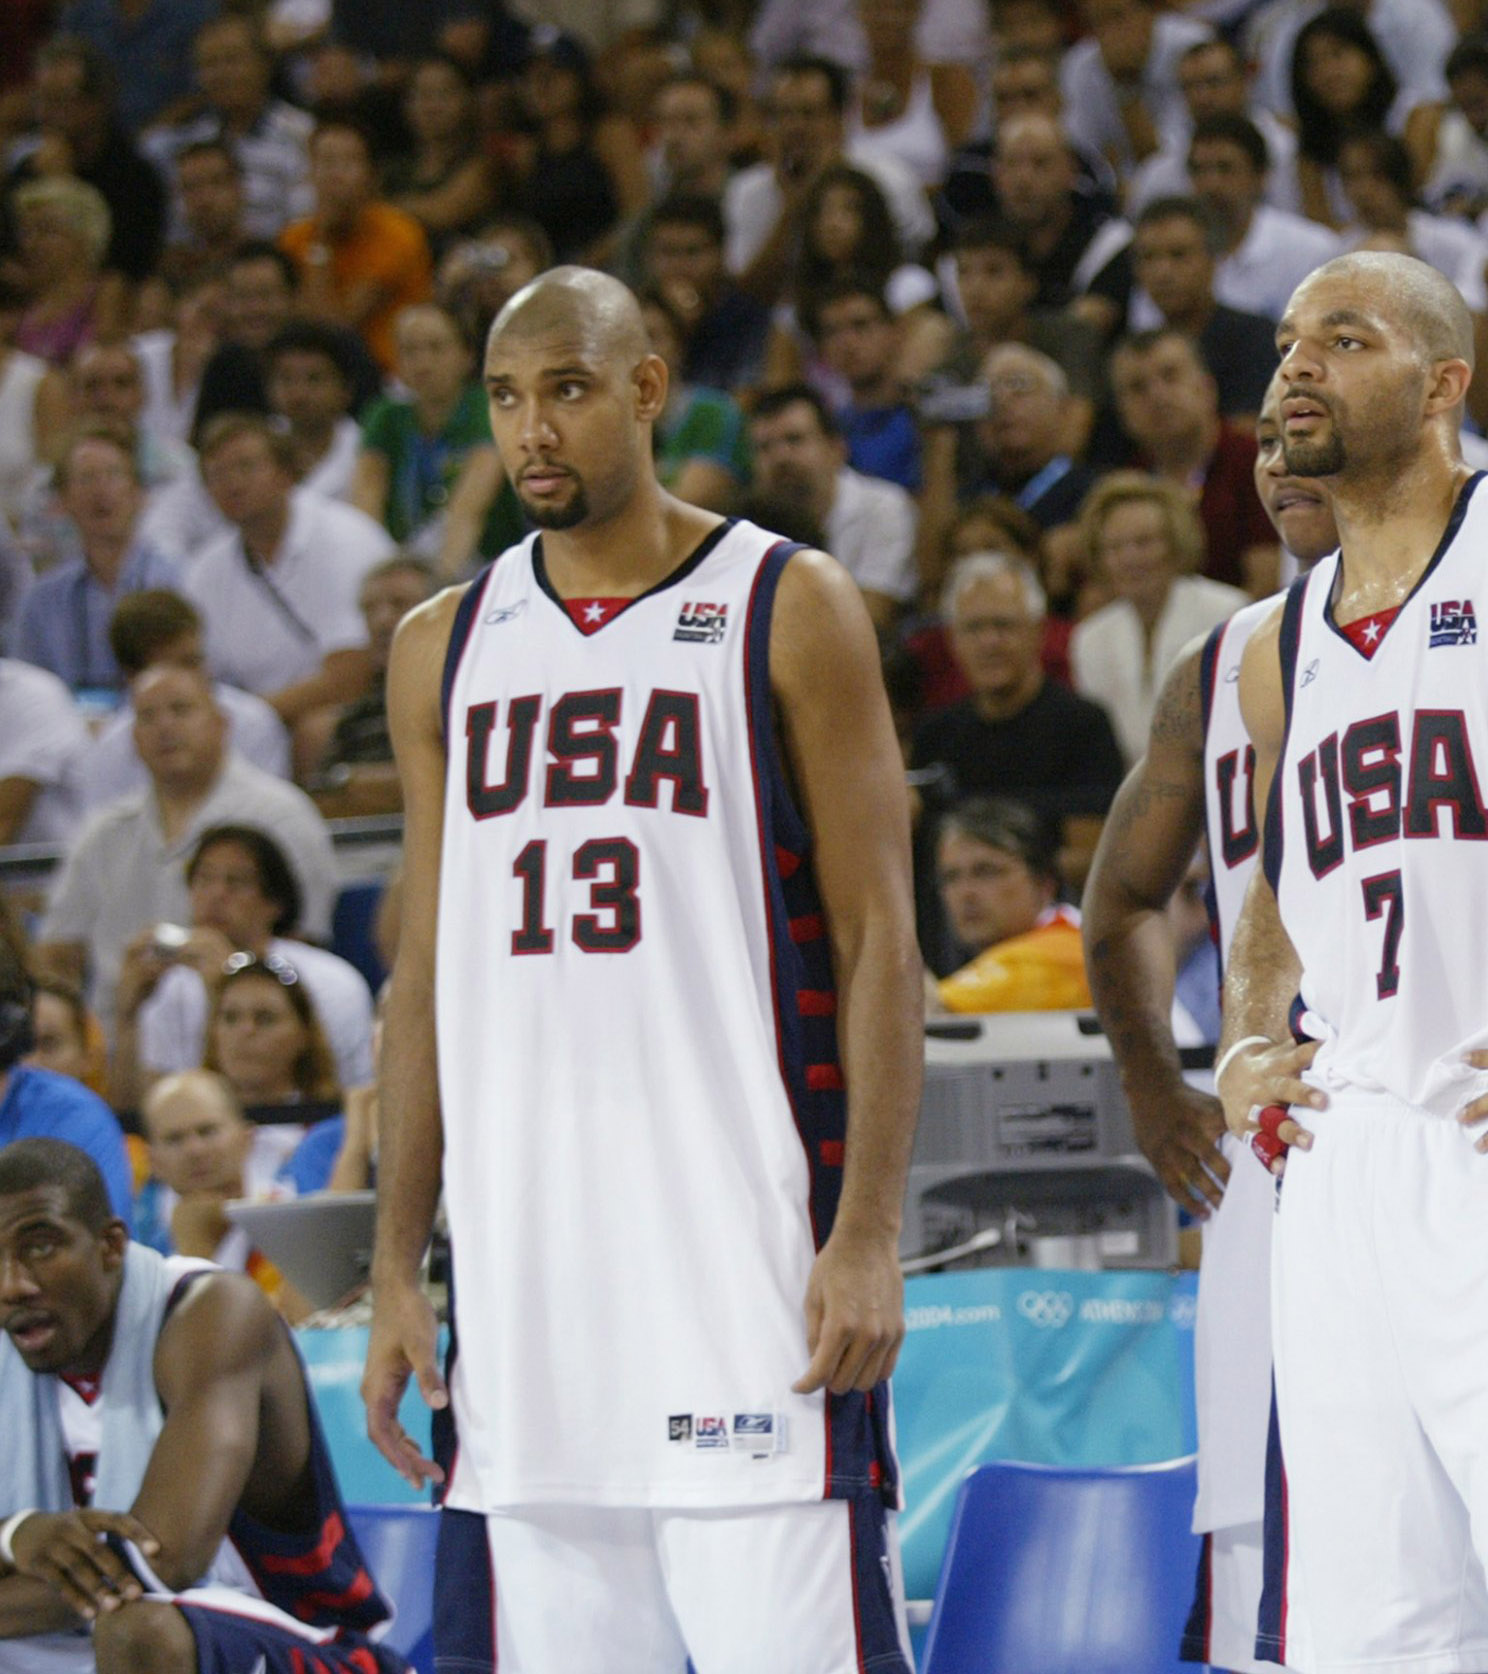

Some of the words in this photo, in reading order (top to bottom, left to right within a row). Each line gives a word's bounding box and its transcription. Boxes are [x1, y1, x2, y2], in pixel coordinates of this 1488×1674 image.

[678, 602, 728, 627] USA
[1431, 599, 1477, 632] USA
[465, 687, 709, 822] USA
[511, 836, 642, 956] 13
[1361, 869, 1404, 1001] 7
